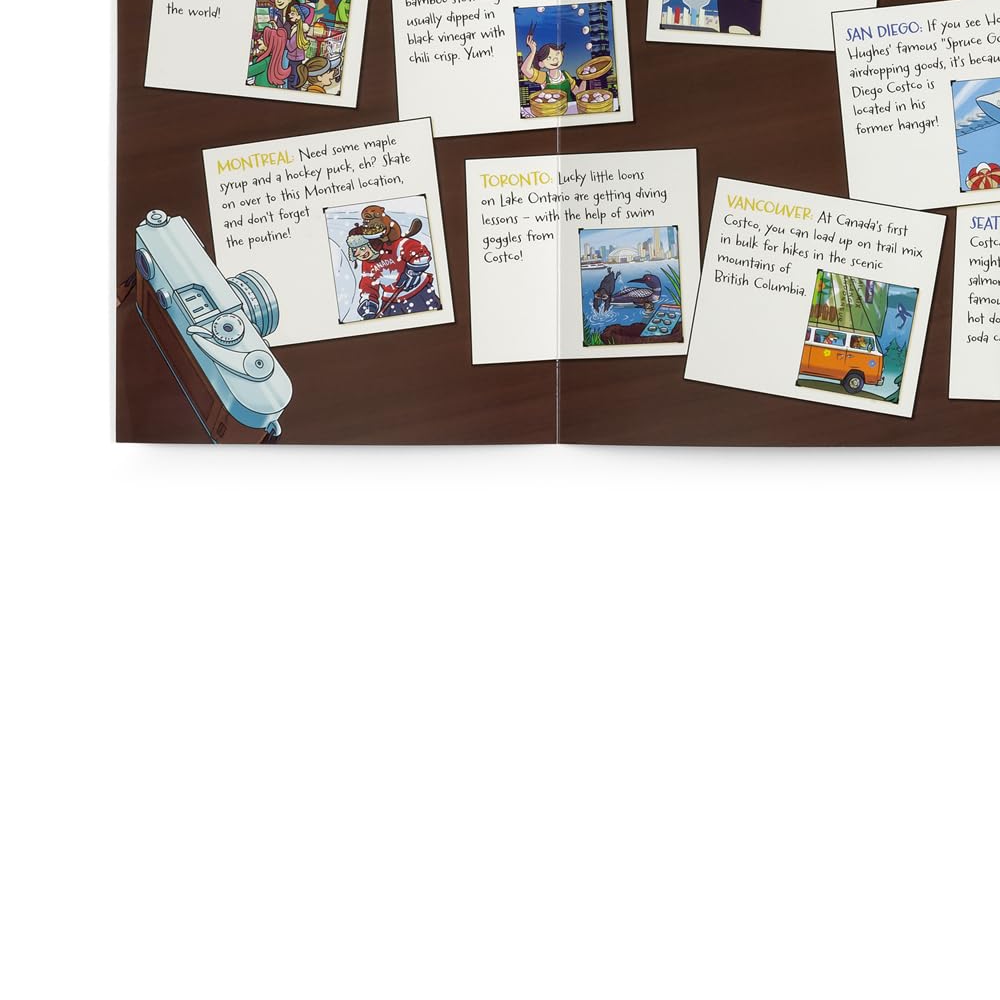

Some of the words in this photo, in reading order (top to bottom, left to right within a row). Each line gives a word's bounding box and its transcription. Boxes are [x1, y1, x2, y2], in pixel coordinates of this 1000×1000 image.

[166, 1, 184, 15] the
[188, 5, 221, 19] world!
[845, 25, 873, 43] SAN
[876, 21, 923, 38] DIEGO:
[926, 18, 938, 33] If
[940, 20, 961, 36] you
[965, 19, 982, 29] see
[408, 50, 430, 64] chili
[433, 50, 461, 66] crisp.
[463, 45, 494, 61] Yum!
[216, 150, 293, 175] MONTREAL:
[298, 143, 328, 163] Need
[331, 143, 360, 156] some
[363, 134, 397, 153] maple
[479, 170, 553, 189] TORONTO:
[557, 168, 587, 188] Lucky
[589, 169, 615, 184] little
[617, 168, 645, 181] loons
[727, 193, 813, 220] VANCOUVER:
[816, 210, 833, 225] At
[836, 213, 883, 233] Canada's
[887, 222, 909, 237] first
[225, 234, 245, 249] the
[247, 226, 292, 250] poutine!
